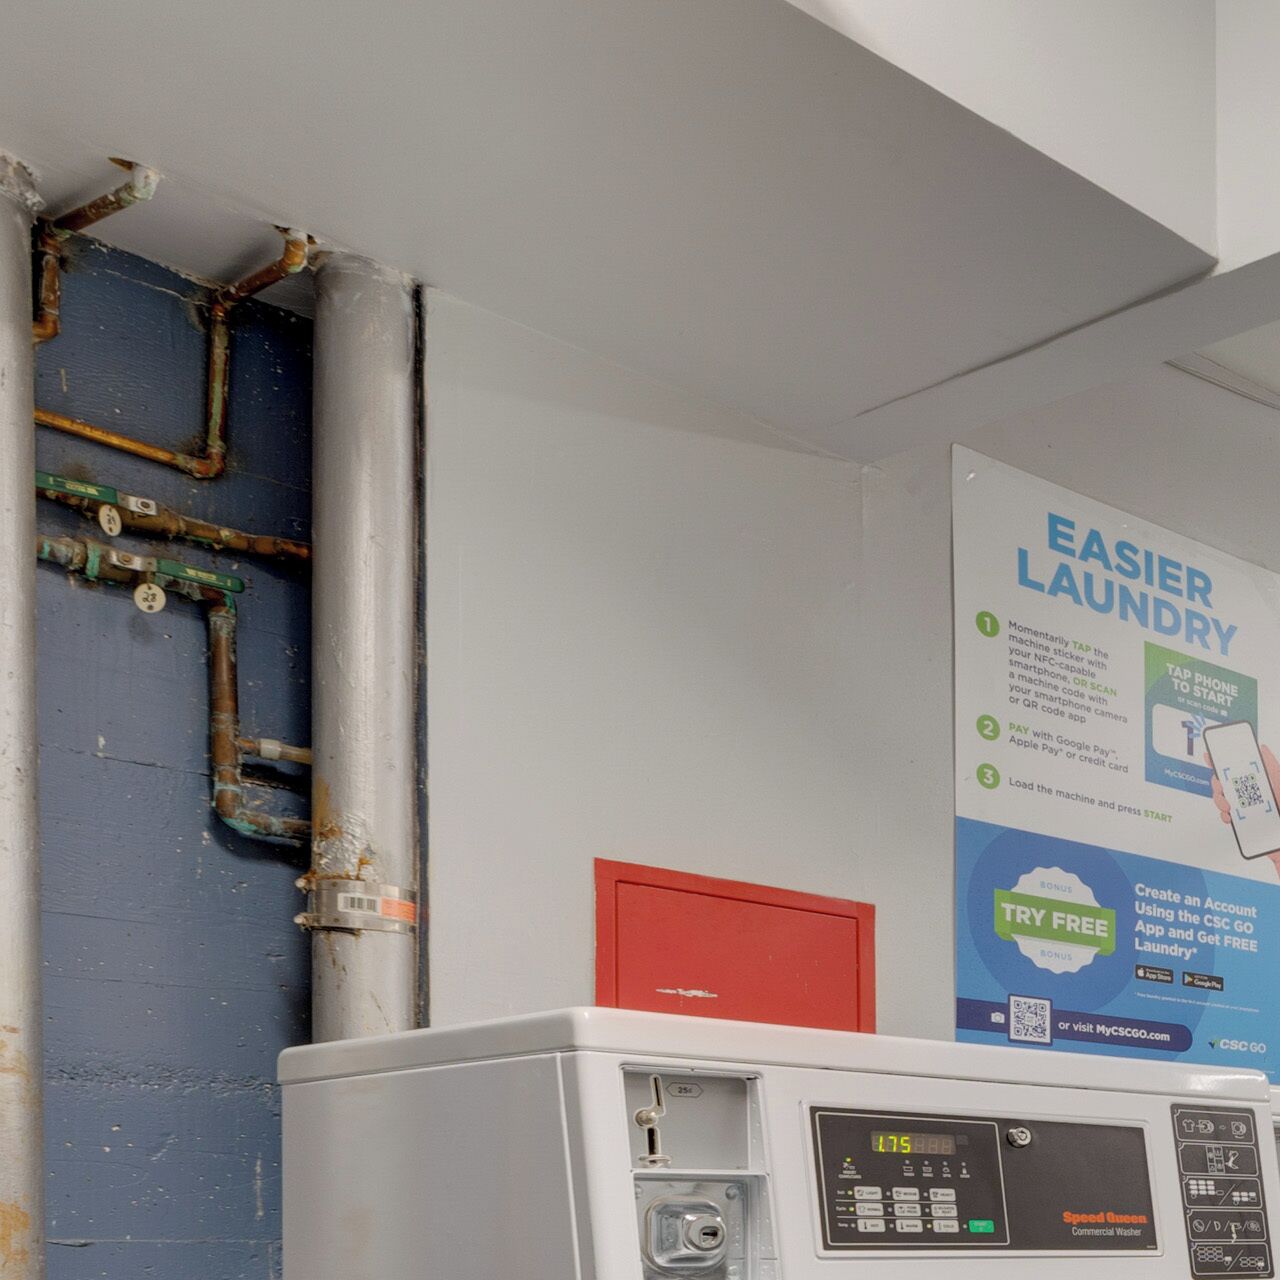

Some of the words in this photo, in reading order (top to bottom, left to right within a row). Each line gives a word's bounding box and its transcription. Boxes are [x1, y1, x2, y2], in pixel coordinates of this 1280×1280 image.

[1047, 512, 1213, 609] EASIER
[1018, 547, 1238, 656] LAUNDRY
[983, 617, 991, 632] 1
[1009, 620, 1069, 647] Momentarily
[1072, 641, 1091, 653] TAP
[1094, 648, 1109, 659] the
[1009, 635, 1050, 653] machine
[1054, 648, 1084, 662] sticker
[1088, 659, 1107, 670] with
[1009, 647, 1031, 659] your
[1035, 653, 1096, 678] NFC-capable
[1009, 671, 1015, 679] a
[1018, 673, 1059, 691] machine
[1062, 685, 1085, 699] code
[1088, 695, 1108, 706] with
[1073, 678, 1088, 688] OR
[1090, 683, 1117, 696] SCAN
[1166, 663, 1192, 679] TAP
[1195, 673, 1238, 697] PHONE
[1172, 678, 1190, 693] TO
[1193, 686, 1234, 707] START
[1009, 683, 1031, 695] your
[1035, 691, 1092, 715] smartphone
[1094, 708, 1128, 723] camera
[1009, 696, 1020, 704] or
[1023, 699, 1039, 710] QR
[1042, 705, 1065, 717] code
[1068, 713, 1086, 723] app
[983, 721, 994, 736] 2
[1009, 723, 1029, 735] PAY
[1032, 729, 1053, 741] with
[1057, 736, 1091, 752] Google
[1009, 736, 1039, 751] Apple
[1079, 754, 1106, 767] credit
[1108, 761, 1129, 773] card
[984, 769, 994, 784] 3
[1008, 777, 1034, 792] Load
[1037, 784, 1053, 795] the
[1056, 788, 1095, 806] machine
[1098, 797, 1115, 810] and
[1117, 803, 1142, 818] press
[1143, 809, 1172, 823] START
[1040, 880, 1072, 893] BONUS
[1135, 883, 1181, 903] Create
[1184, 895, 1201, 907] an
[1204, 897, 1257, 918] Account
[1001, 902, 1046, 928] TRY
[1052, 911, 1108, 938] FREE
[1135, 901, 1175, 922] Using
[1178, 910, 1200, 924] the
[1204, 914, 1230, 930] CSC
[1234, 920, 1253, 934] GO
[1135, 920, 1164, 937] App
[1168, 927, 1193, 941] and
[1197, 931, 1220, 946] Get
[1224, 936, 1258, 952] FREE
[1040, 951, 1072, 961] BONUS
[1158, 973, 1171, 981] Store
[1194, 979, 1211, 988] Google
[1058, 1021, 1069, 1031] or
[1072, 1021, 1094, 1034] visit
[1096, 1023, 1170, 1042] MyCSCGO.com
[1220, 1038, 1248, 1052] CSC
[1250, 1042, 1266, 1053] GO
[1063, 1211, 1105, 1225] Speed
[1106, 1212, 1147, 1223] Queen
[1071, 1226, 1114, 1236] Commercial
[1116, 1227, 1142, 1236] Washer
